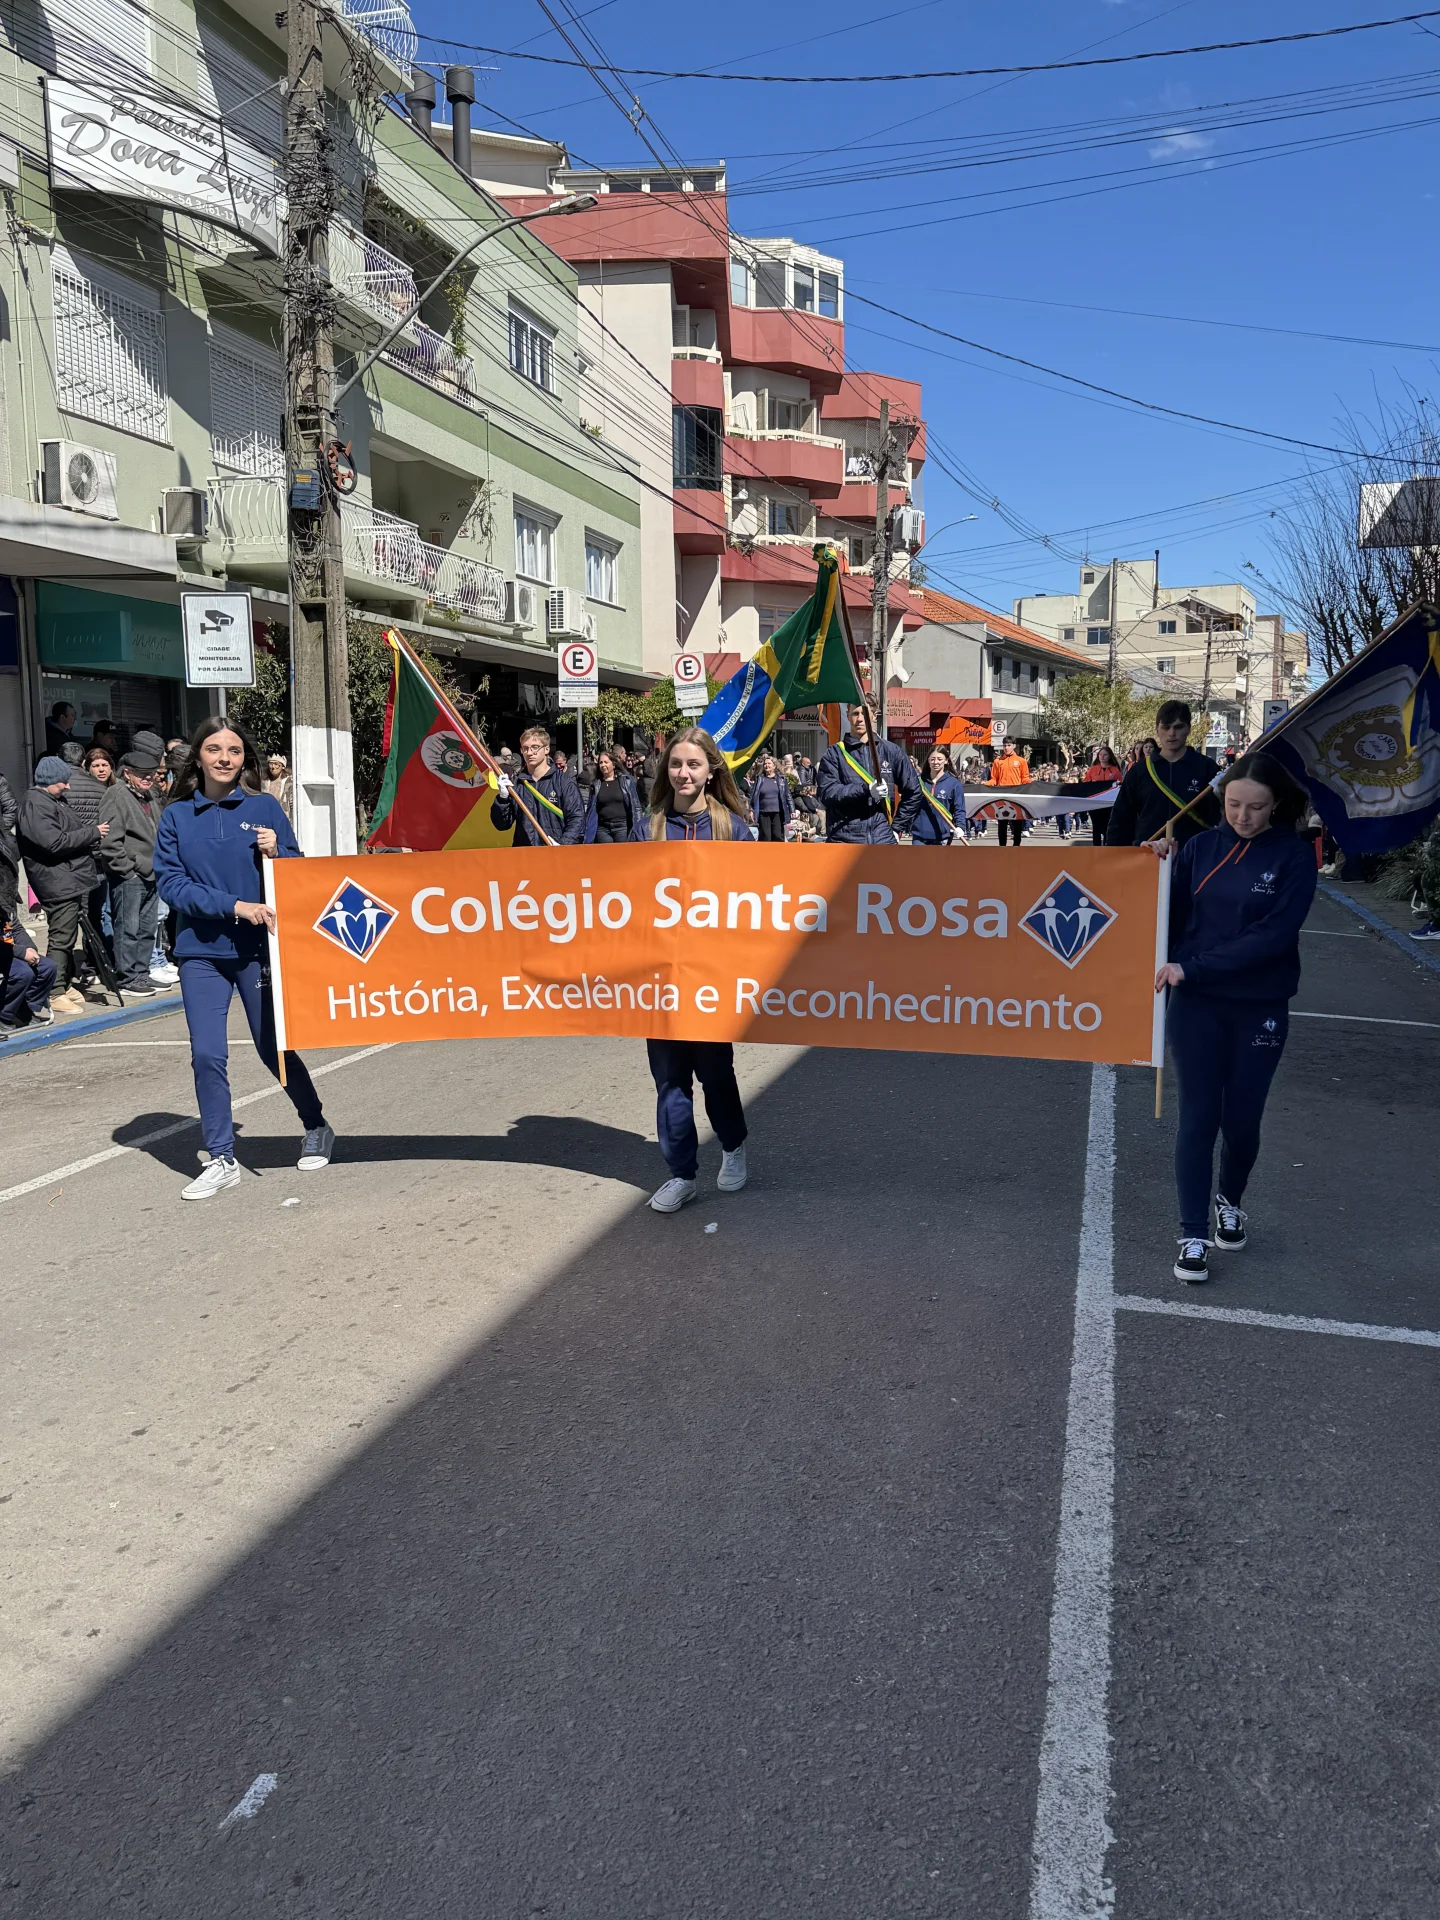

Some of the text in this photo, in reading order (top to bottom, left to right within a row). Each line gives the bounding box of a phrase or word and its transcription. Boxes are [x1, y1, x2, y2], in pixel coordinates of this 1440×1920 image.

[110, 95, 217, 148] Pousada
[61, 112, 273, 221] Dona Luiza
[572, 651, 584, 670] E
[682, 660, 694, 676] E
[43, 687, 76, 699] OUTLET
[996, 723, 1002, 732] E
[411, 878, 1008, 943] Colégio Santa Rosa
[328, 974, 1102, 1031] História, Excelência e Reconhecimento
